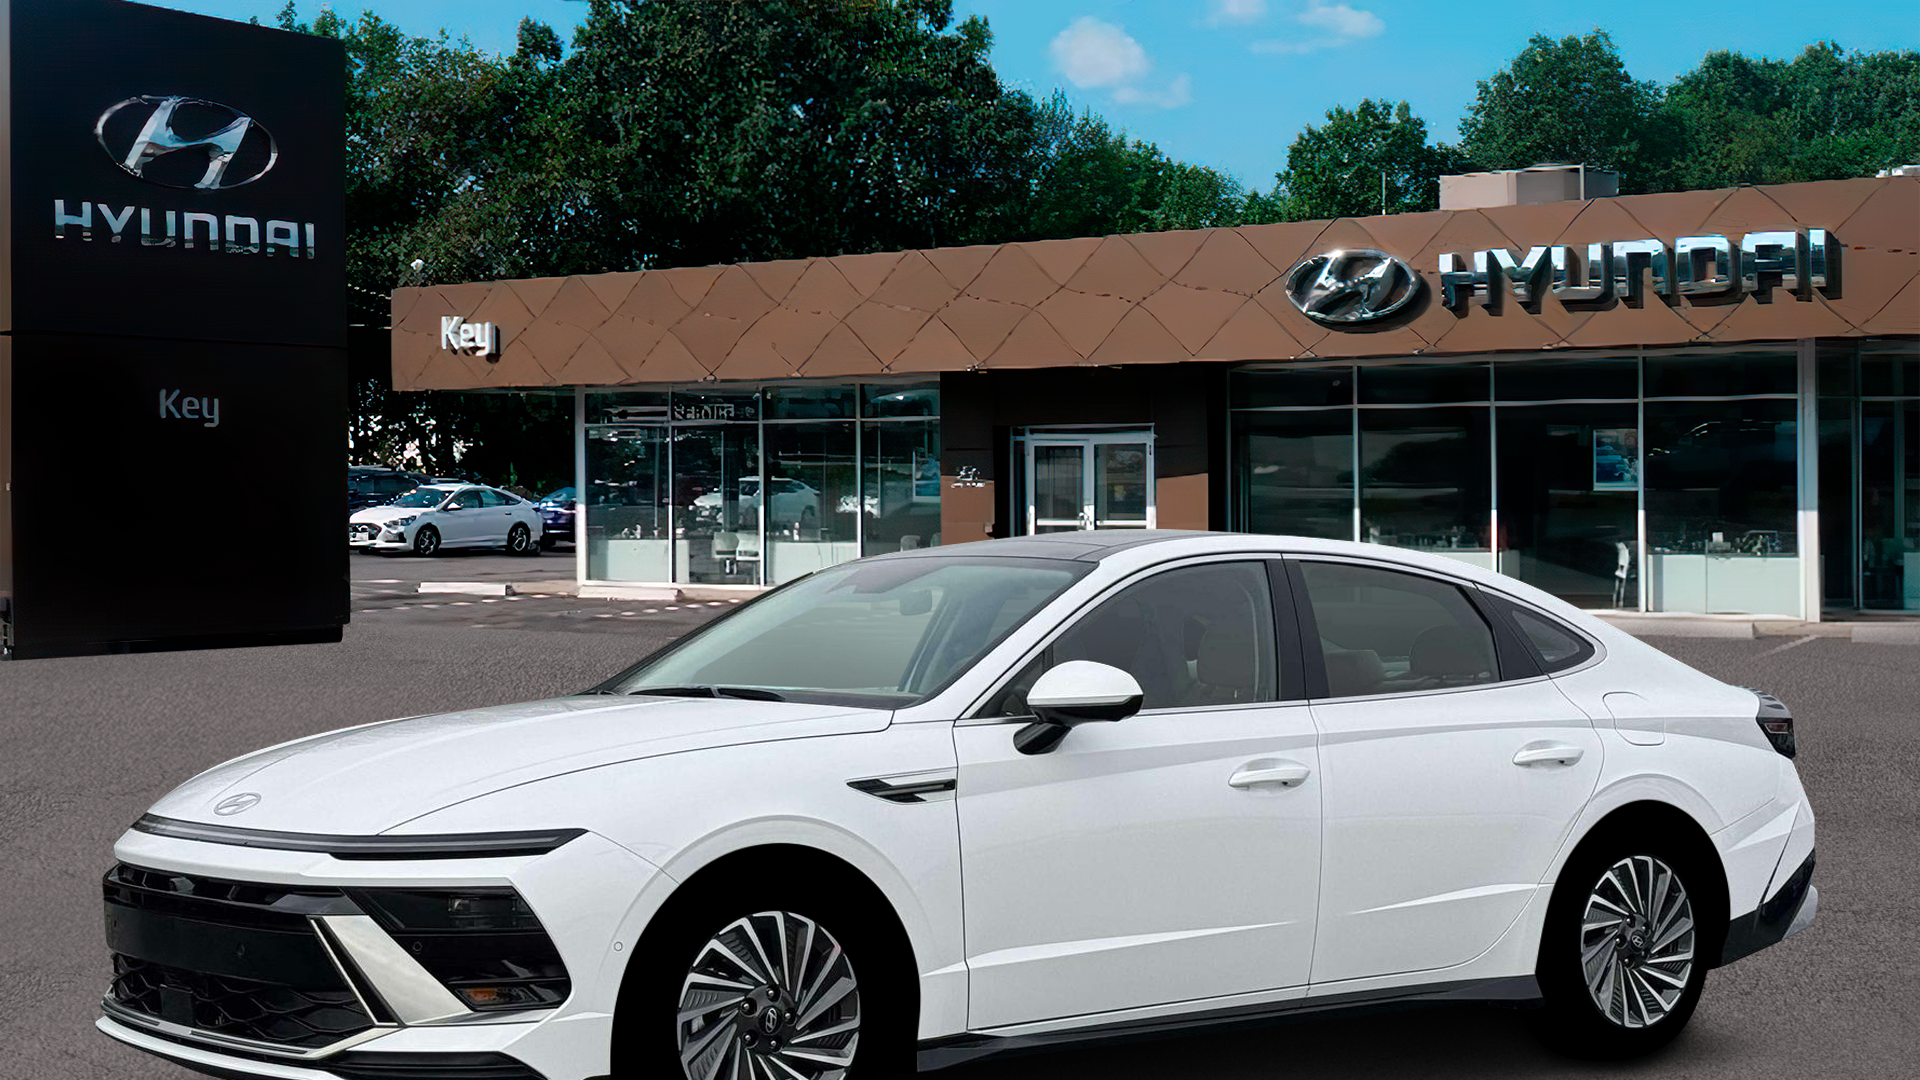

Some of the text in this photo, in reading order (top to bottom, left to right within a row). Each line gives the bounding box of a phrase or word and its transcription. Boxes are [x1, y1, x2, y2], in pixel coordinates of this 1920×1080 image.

[54, 199, 315, 260] HYUNDAI
[1438, 228, 1841, 316] HYUNDAI
[441, 316, 494, 357] Key
[159, 388, 219, 427] Key
